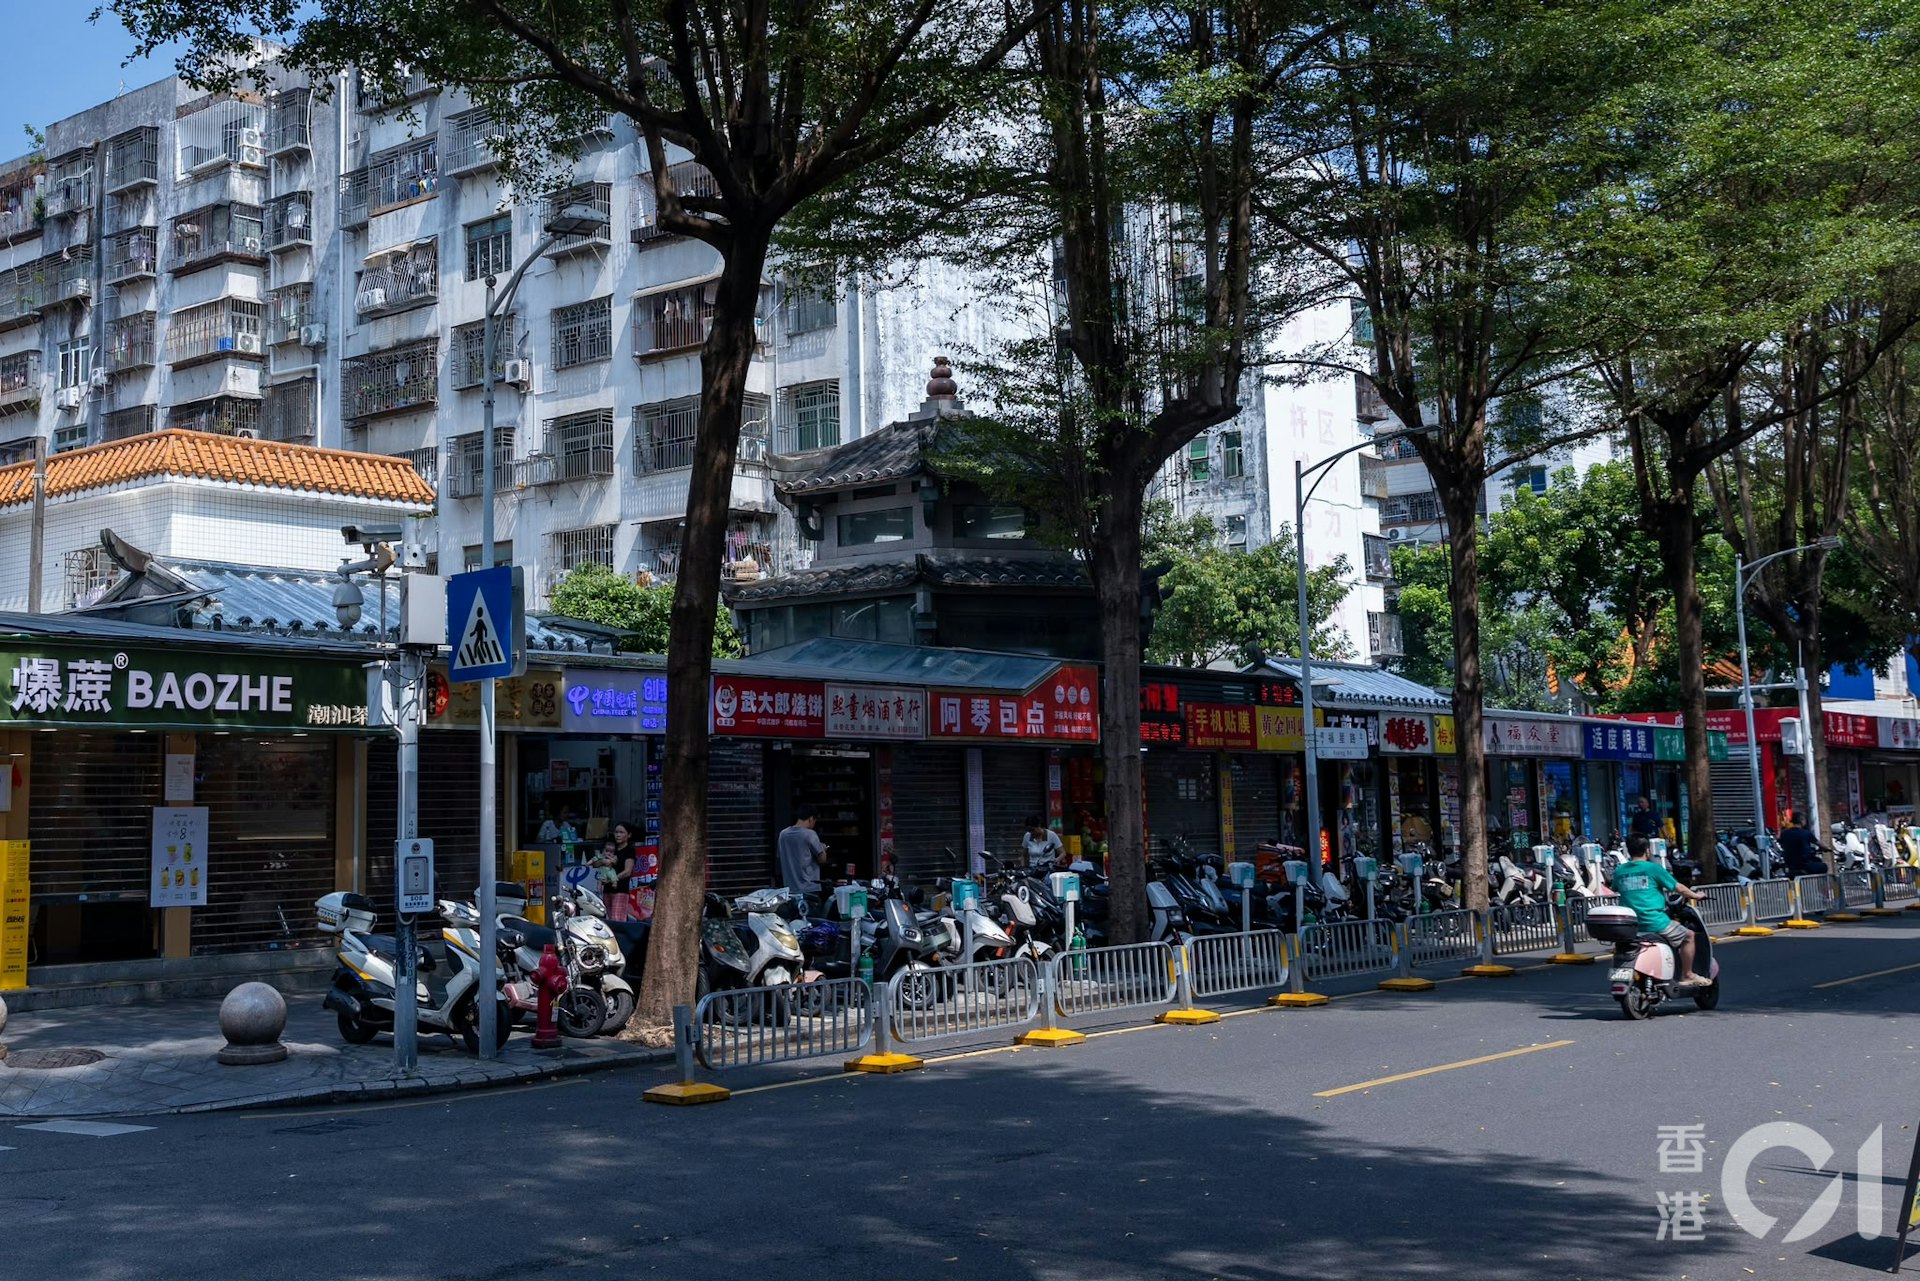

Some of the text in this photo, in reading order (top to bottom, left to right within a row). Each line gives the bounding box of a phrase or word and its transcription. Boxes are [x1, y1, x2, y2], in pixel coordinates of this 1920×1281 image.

[11, 656, 112, 713] 爆蔗
[127, 670, 293, 713] BAOZHE
[592, 686, 638, 709] 中国电信
[611, 709, 638, 717] TELECOM
[741, 689, 823, 718] 武大郎烧饼
[940, 697, 1045, 735] 阿琴包点
[1195, 708, 1251, 735] 手机贴膜
[1507, 725, 1560, 744] 福众堂
[1592, 726, 1647, 752] 适度眼镜
